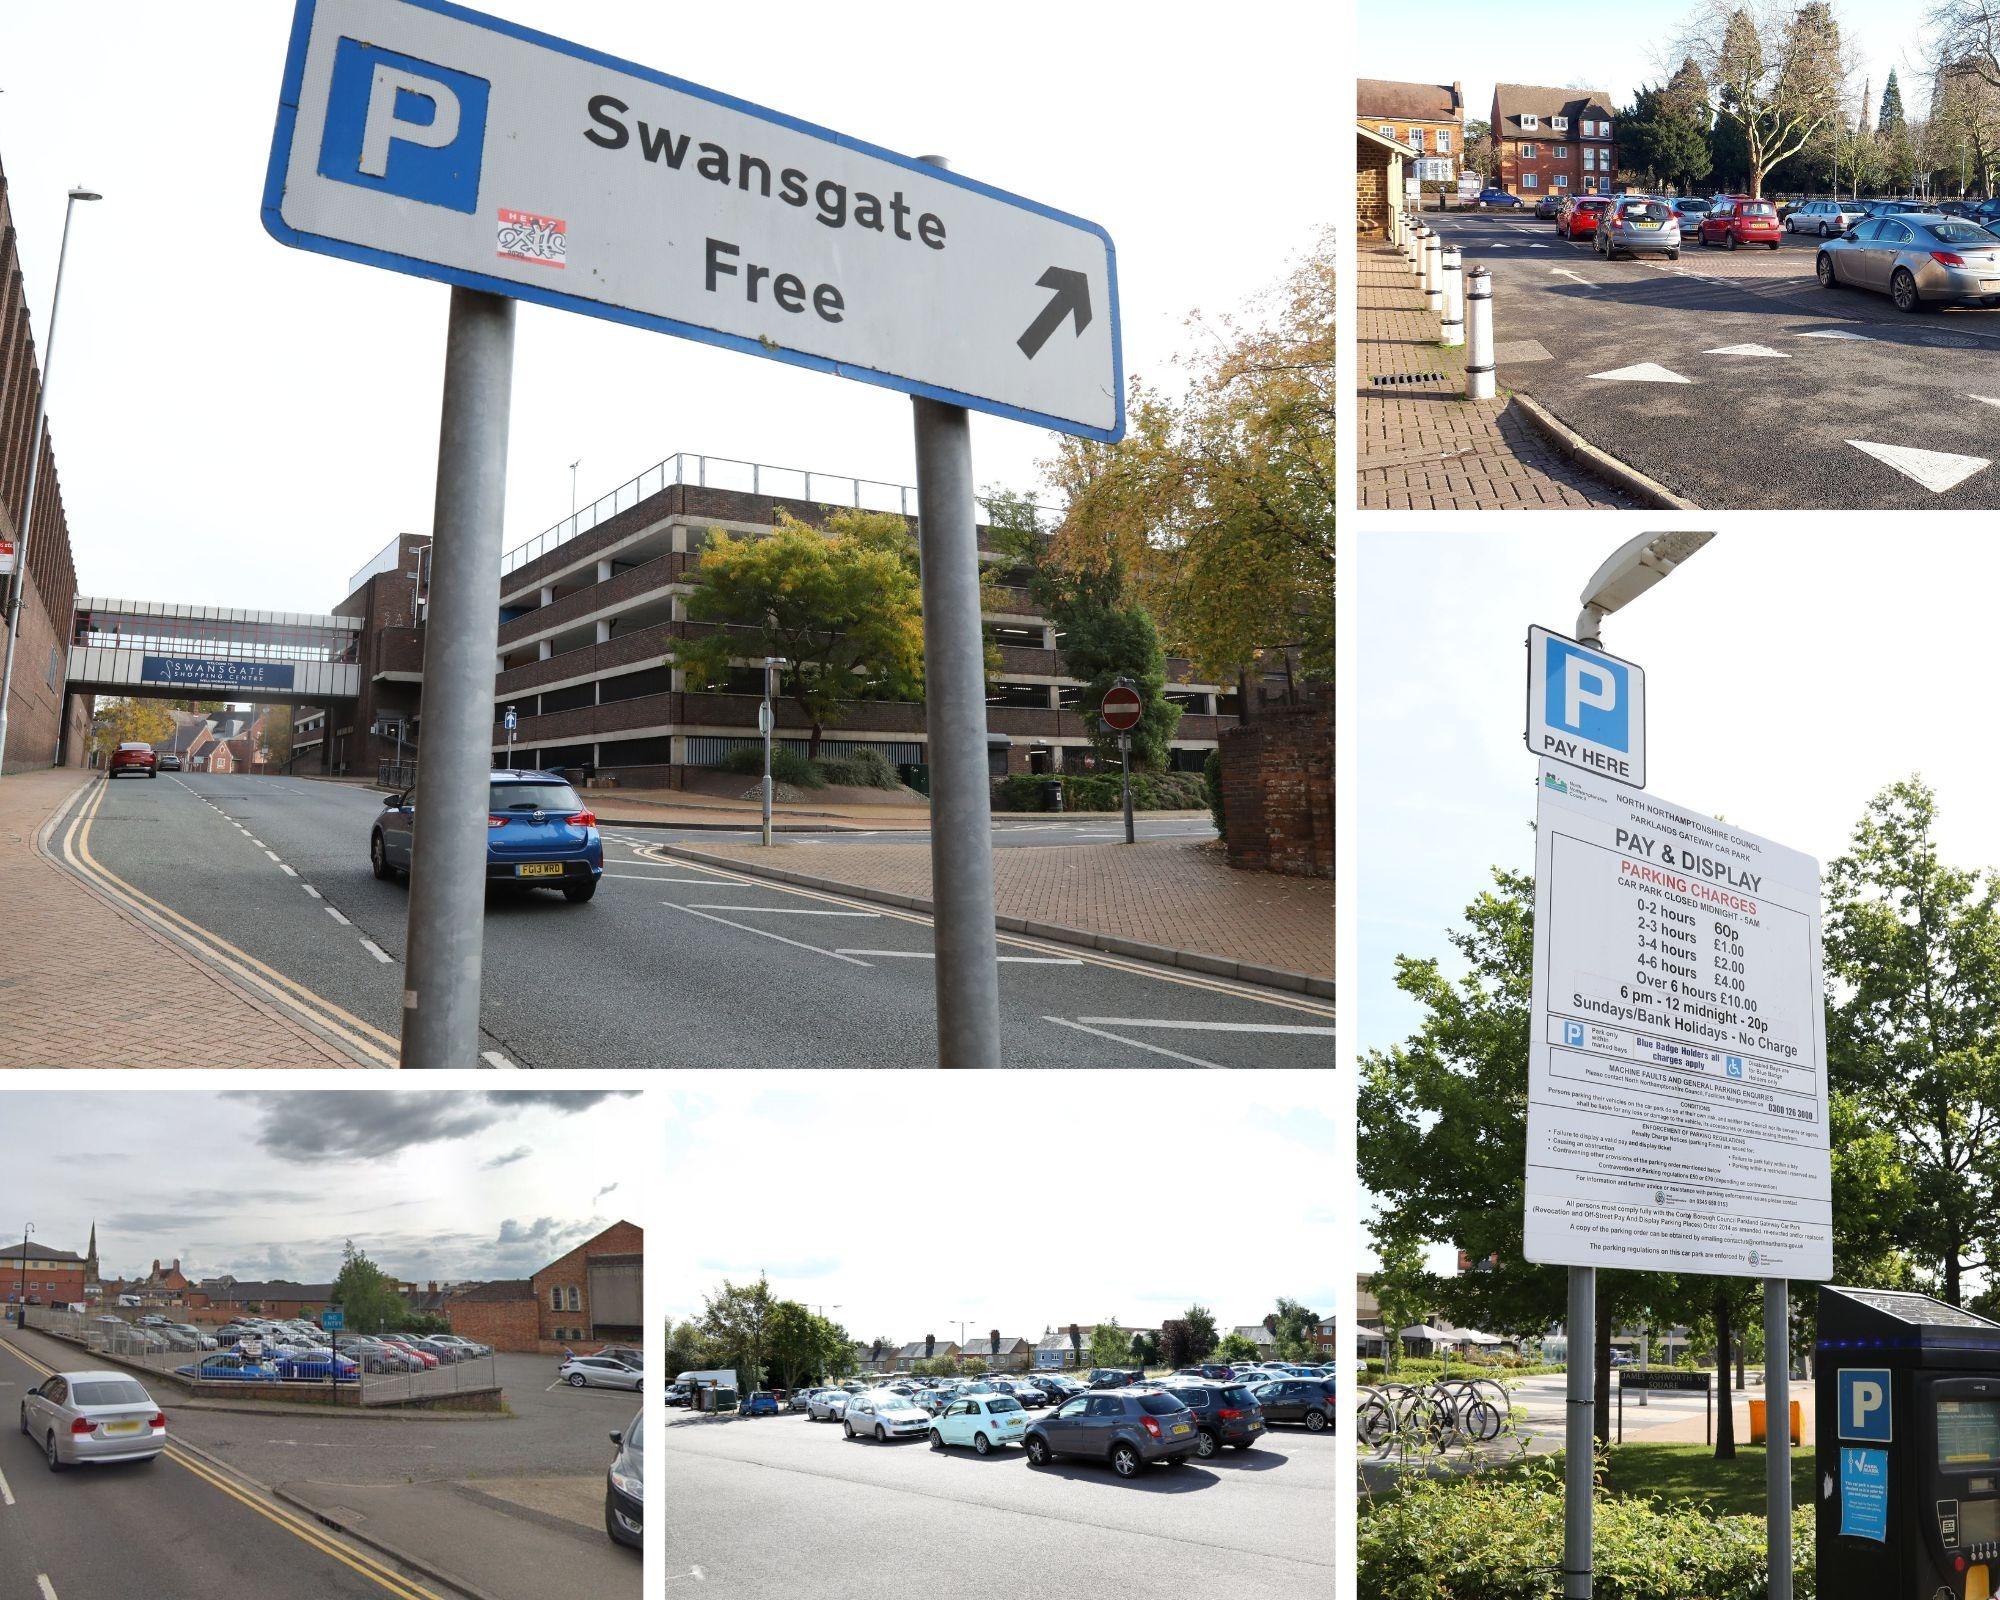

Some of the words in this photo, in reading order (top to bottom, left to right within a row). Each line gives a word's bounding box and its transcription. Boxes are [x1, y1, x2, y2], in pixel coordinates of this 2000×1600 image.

[358, 63, 460, 178] P
[583, 94, 946, 250] Swansgate
[508, 212, 557, 226] HEL
[705, 236, 845, 323] Free
[174, 663, 264, 676] SWANSGATE
[174, 671, 223, 680] SHOPPING
[229, 674, 264, 682] CENTRE
[1564, 652, 1616, 728] P
[1544, 734, 1578, 758] PAY
[1582, 748, 1630, 778] HERE
[1616, 793, 1645, 811] NORTH
[1647, 804, 1728, 841] NORTHAMPTONSHIRE
[1730, 835, 1761, 853] COUNCIL
[1630, 813, 1677, 836] PARKLANDS
[1678, 830, 1713, 849] GATEWAY
[1715, 843, 1730, 855] CAR
[1731, 849, 1750, 862] PARK
[522, 864, 542, 873] FG13
[1615, 827, 1654, 858] PAY
[1661, 843, 1675, 865] &
[1681, 850, 1761, 894] DISPLAY
[1617, 876, 1637, 890] CAR
[1639, 882, 1662, 897] PARK
[1664, 890, 1697, 908] CLOSED
[1700, 902, 1738, 921] MIDNIGHT
[1744, 916, 1759, 928] 5AM
[1621, 859, 1686, 893] PARKING
[1691, 882, 1756, 915] CHARGES
[1637, 897, 1656, 914] 0-2
[1660, 904, 1695, 926] hours
[1714, 921, 1738, 943] 60p
[1638, 915, 1656, 933] 2-3
[1661, 922, 1696, 944] hours
[1714, 937, 1744, 957] £1.00
[1637, 934, 1657, 951] 3-4
[1661, 940, 1696, 961] hours
[1714, 955, 1744, 974] £2.00
[1637, 952, 1657, 969] 4-6
[1661, 958, 1696, 979] hours
[1714, 972, 1744, 992] £4.00
[1620, 985, 1628, 998] 6
[1632, 991, 1652, 1007] pm
[1665, 995, 1679, 1011] 12
[1683, 1000, 1737, 1027] midnight
[1747, 1015, 1768, 1034] 20p
[1636, 970, 1666, 990] Over
[1670, 979, 1677, 992] 6
[1682, 982, 1716, 1002] hours
[1720, 992, 1757, 1012] £10.00
[1567, 1023, 1580, 1045] P
[1572, 993, 1670, 1030] Sundays/Bank
[1674, 1016, 1727, 1043] Holidays
[1739, 1031, 1754, 1046] No
[1758, 1036, 1797, 1058] Charge
[1591, 1027, 1604, 1035] Park
[1604, 1030, 1618, 1039] only
[1591, 1041, 1612, 1050] marked
[1613, 1045, 1627, 1054] bays
[1636, 1037, 1653, 1048] Blue
[1655, 1041, 1678, 1055] Badge
[1681, 1047, 1708, 1059] Holders
[1711, 1053, 1719, 1062] all
[1652, 1052, 1682, 1067] charges
[1685, 1058, 1704, 1071] apply
[1585, 1069, 1603, 1077] Please
[1604, 1072, 1623, 1081] contact
[1608, 1064, 1640, 1076] MACHINE
[1642, 1070, 1666, 1081] FAULTS
[1667, 1075, 1681, 1084] AND
[1683, 1078, 1712, 1090] GENERAL
[1714, 1084, 1741, 1095] PARKING
[1742, 1090, 1773, 1102] ENQUIRIES
[1680, 1101, 1710, 1111] CONDITIONS
[1768, 1103, 1784, 1114] 0300
[1786, 1107, 1796, 1116] 126
[1642, 1123, 1680, 1134] ENFORCEMENT
[1689, 1130, 1711, 1139] PARKING
[1712, 1134, 1745, 1144] REGULATIONS
[1575, 1203, 1599, 1211] persons
[1617, 1206, 1638, 1214] comply
[1639, 1208, 1651, 1216] fully
[1610, 1227, 1632, 1235] parking
[1603, 1244, 1625, 1252] parking
[1627, 1245, 1659, 1255] regulations
[1691, 1250, 1704, 1258] park
[1622, 1372, 1646, 1380] JAMES
[1648, 1373, 1693, 1381] ASHWORTH
[1697, 1374, 1708, 1382] VC
[1648, 1381, 1679, 1389] SQUARE
[1852, 1381, 1883, 1428] P
